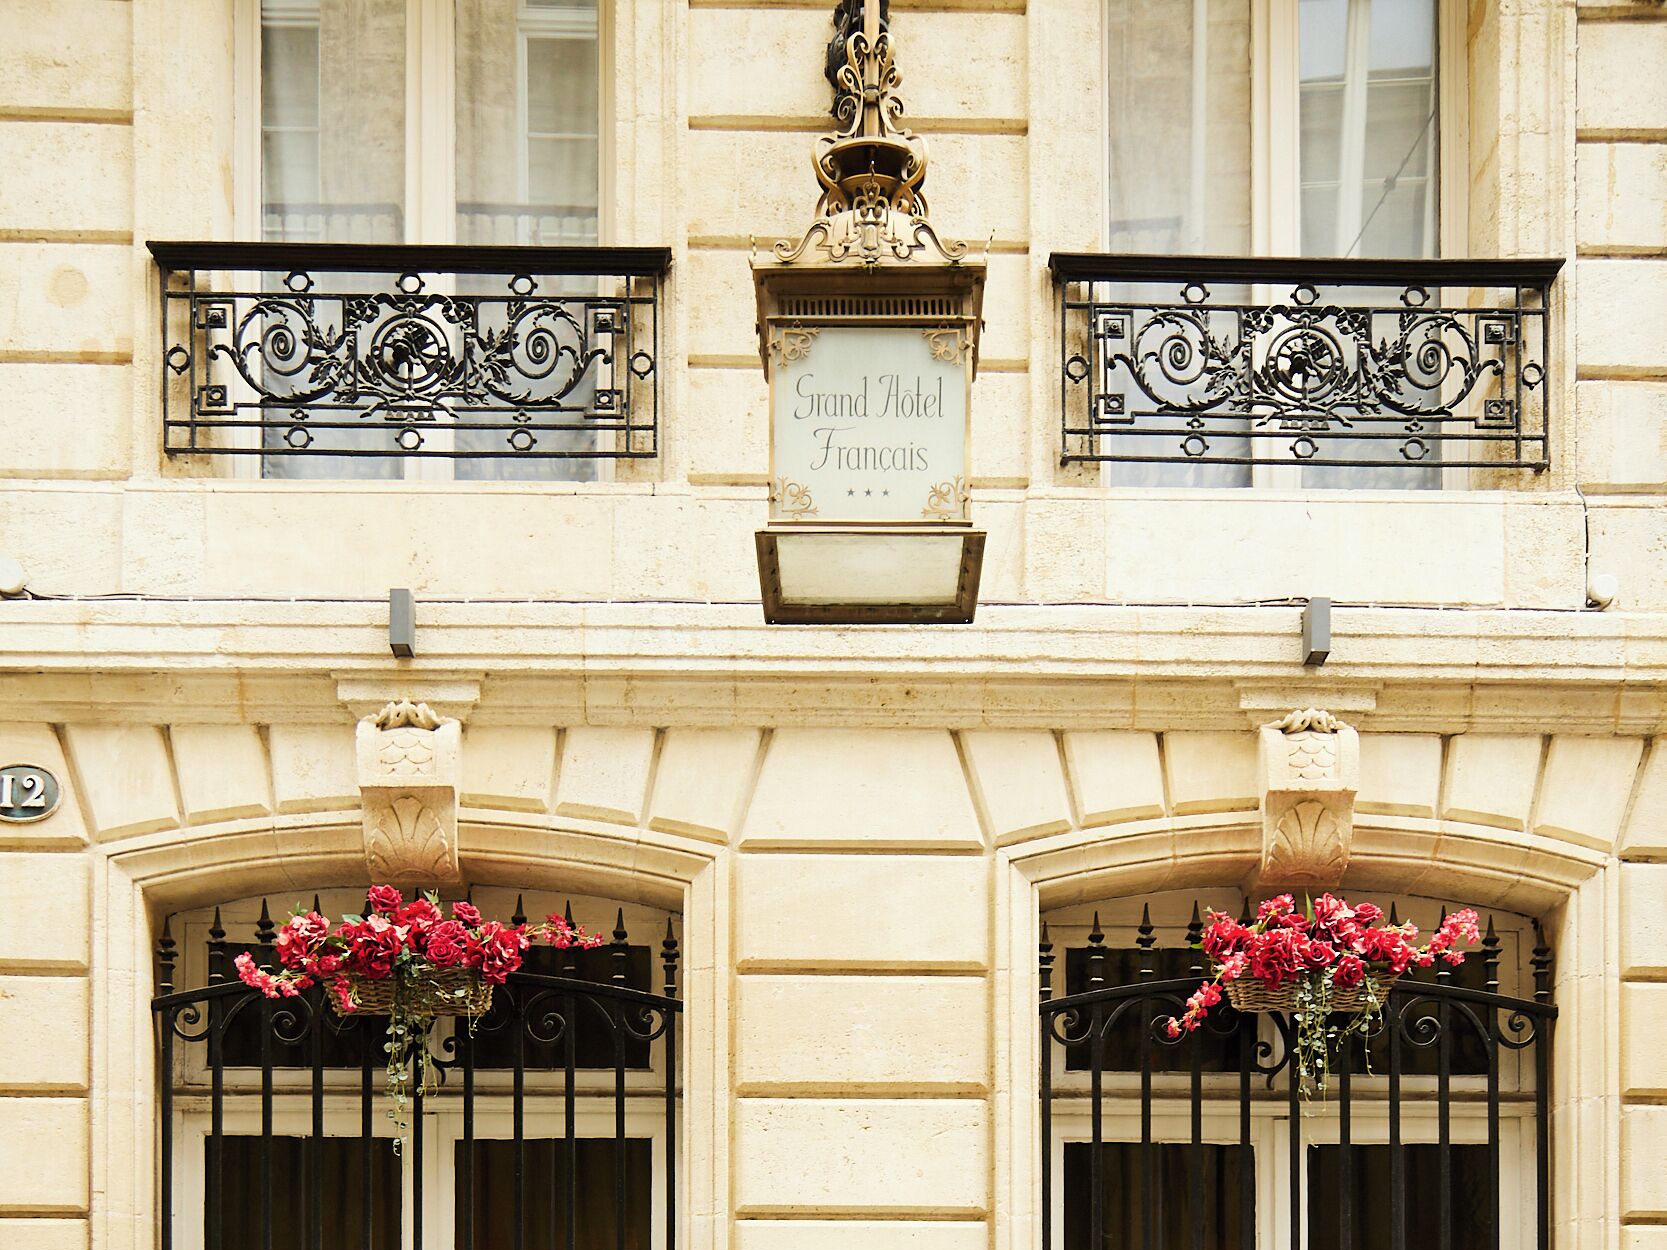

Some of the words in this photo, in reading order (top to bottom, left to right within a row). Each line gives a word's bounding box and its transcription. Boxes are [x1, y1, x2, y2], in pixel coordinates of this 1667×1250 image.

[794, 373, 869, 420] Grand
[875, 373, 944, 419] Hôtel
[810, 426, 928, 473] Français
[0, 774, 46, 809] 12
